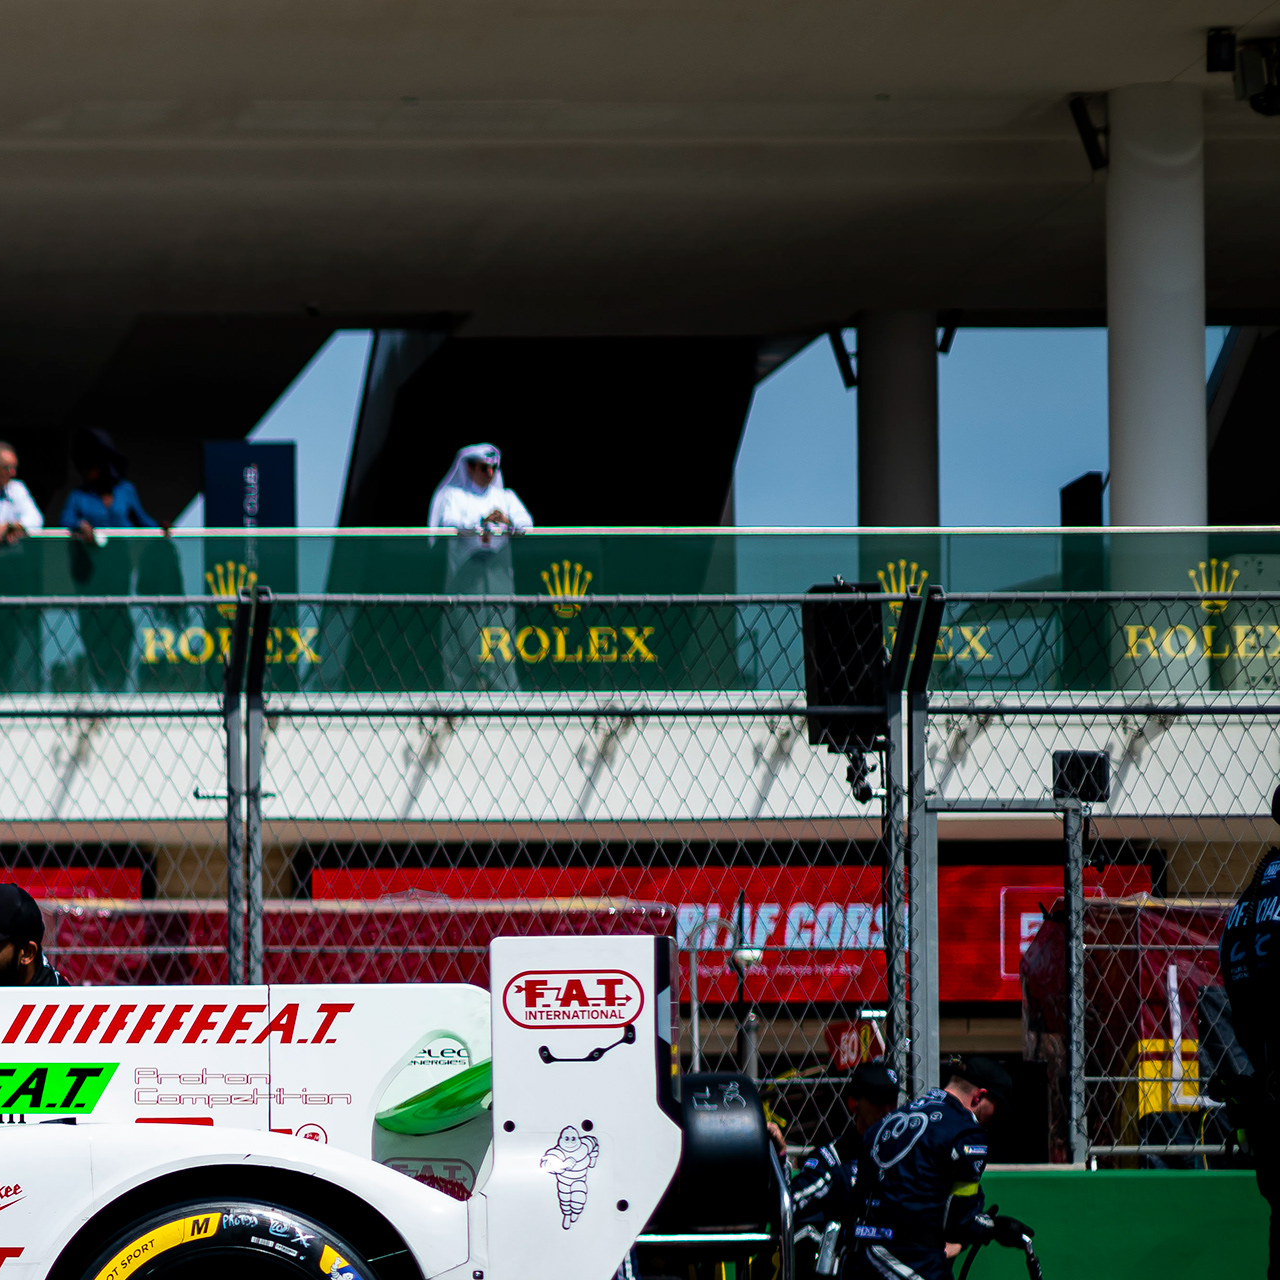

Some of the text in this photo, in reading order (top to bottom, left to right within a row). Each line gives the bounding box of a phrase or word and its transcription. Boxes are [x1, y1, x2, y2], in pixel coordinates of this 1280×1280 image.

[477, 626, 658, 663] ROLEX
[784, 901, 910, 947] CORS
[524, 1009, 625, 1021] INTERNATIONAL
[134, 1067, 271, 1085] Proton
[134, 1086, 352, 1106] Competition
[120, 1238, 156, 1270] SPORT
